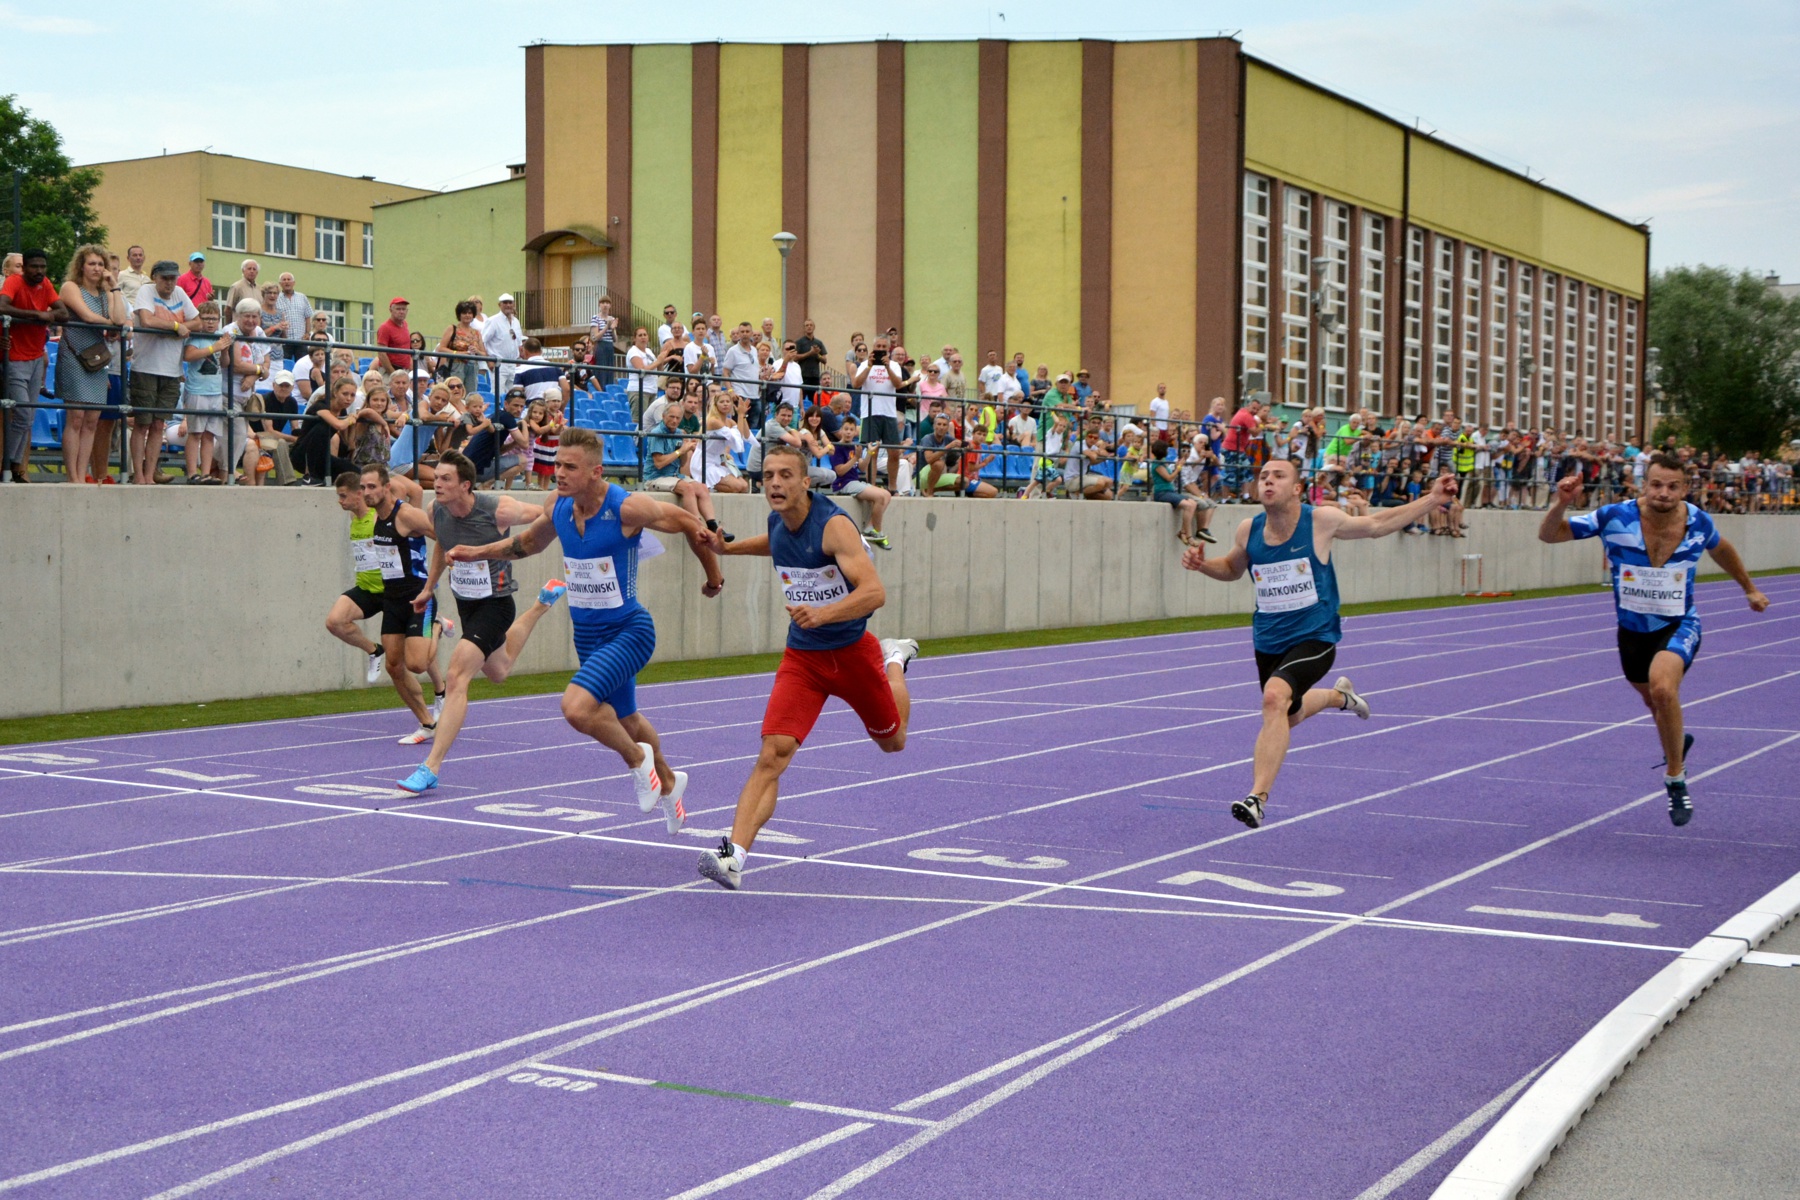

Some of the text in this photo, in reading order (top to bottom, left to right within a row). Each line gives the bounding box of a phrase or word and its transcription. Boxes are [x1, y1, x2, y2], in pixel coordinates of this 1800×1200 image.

[569, 561, 594, 570] GRAND
[1261, 564, 1292, 575] GRAND
[574, 571, 592, 579] PRIX
[790, 570, 820, 579] GRAND
[1267, 574, 1289, 583] PRIX
[1637, 569, 1670, 579] GRAND
[797, 580, 818, 588] PRIX
[1641, 579, 1664, 587] PRIX
[785, 584, 845, 602] OLSZEWSKI
[1621, 586, 1684, 600] ZIMNIEWICZ
[145, 767, 261, 782] 7
[293, 783, 421, 800] 6
[473, 803, 618, 822] 5
[907, 847, 1084, 870] 3
[1157, 870, 1345, 897] 2
[1465, 905, 1661, 929] 1
